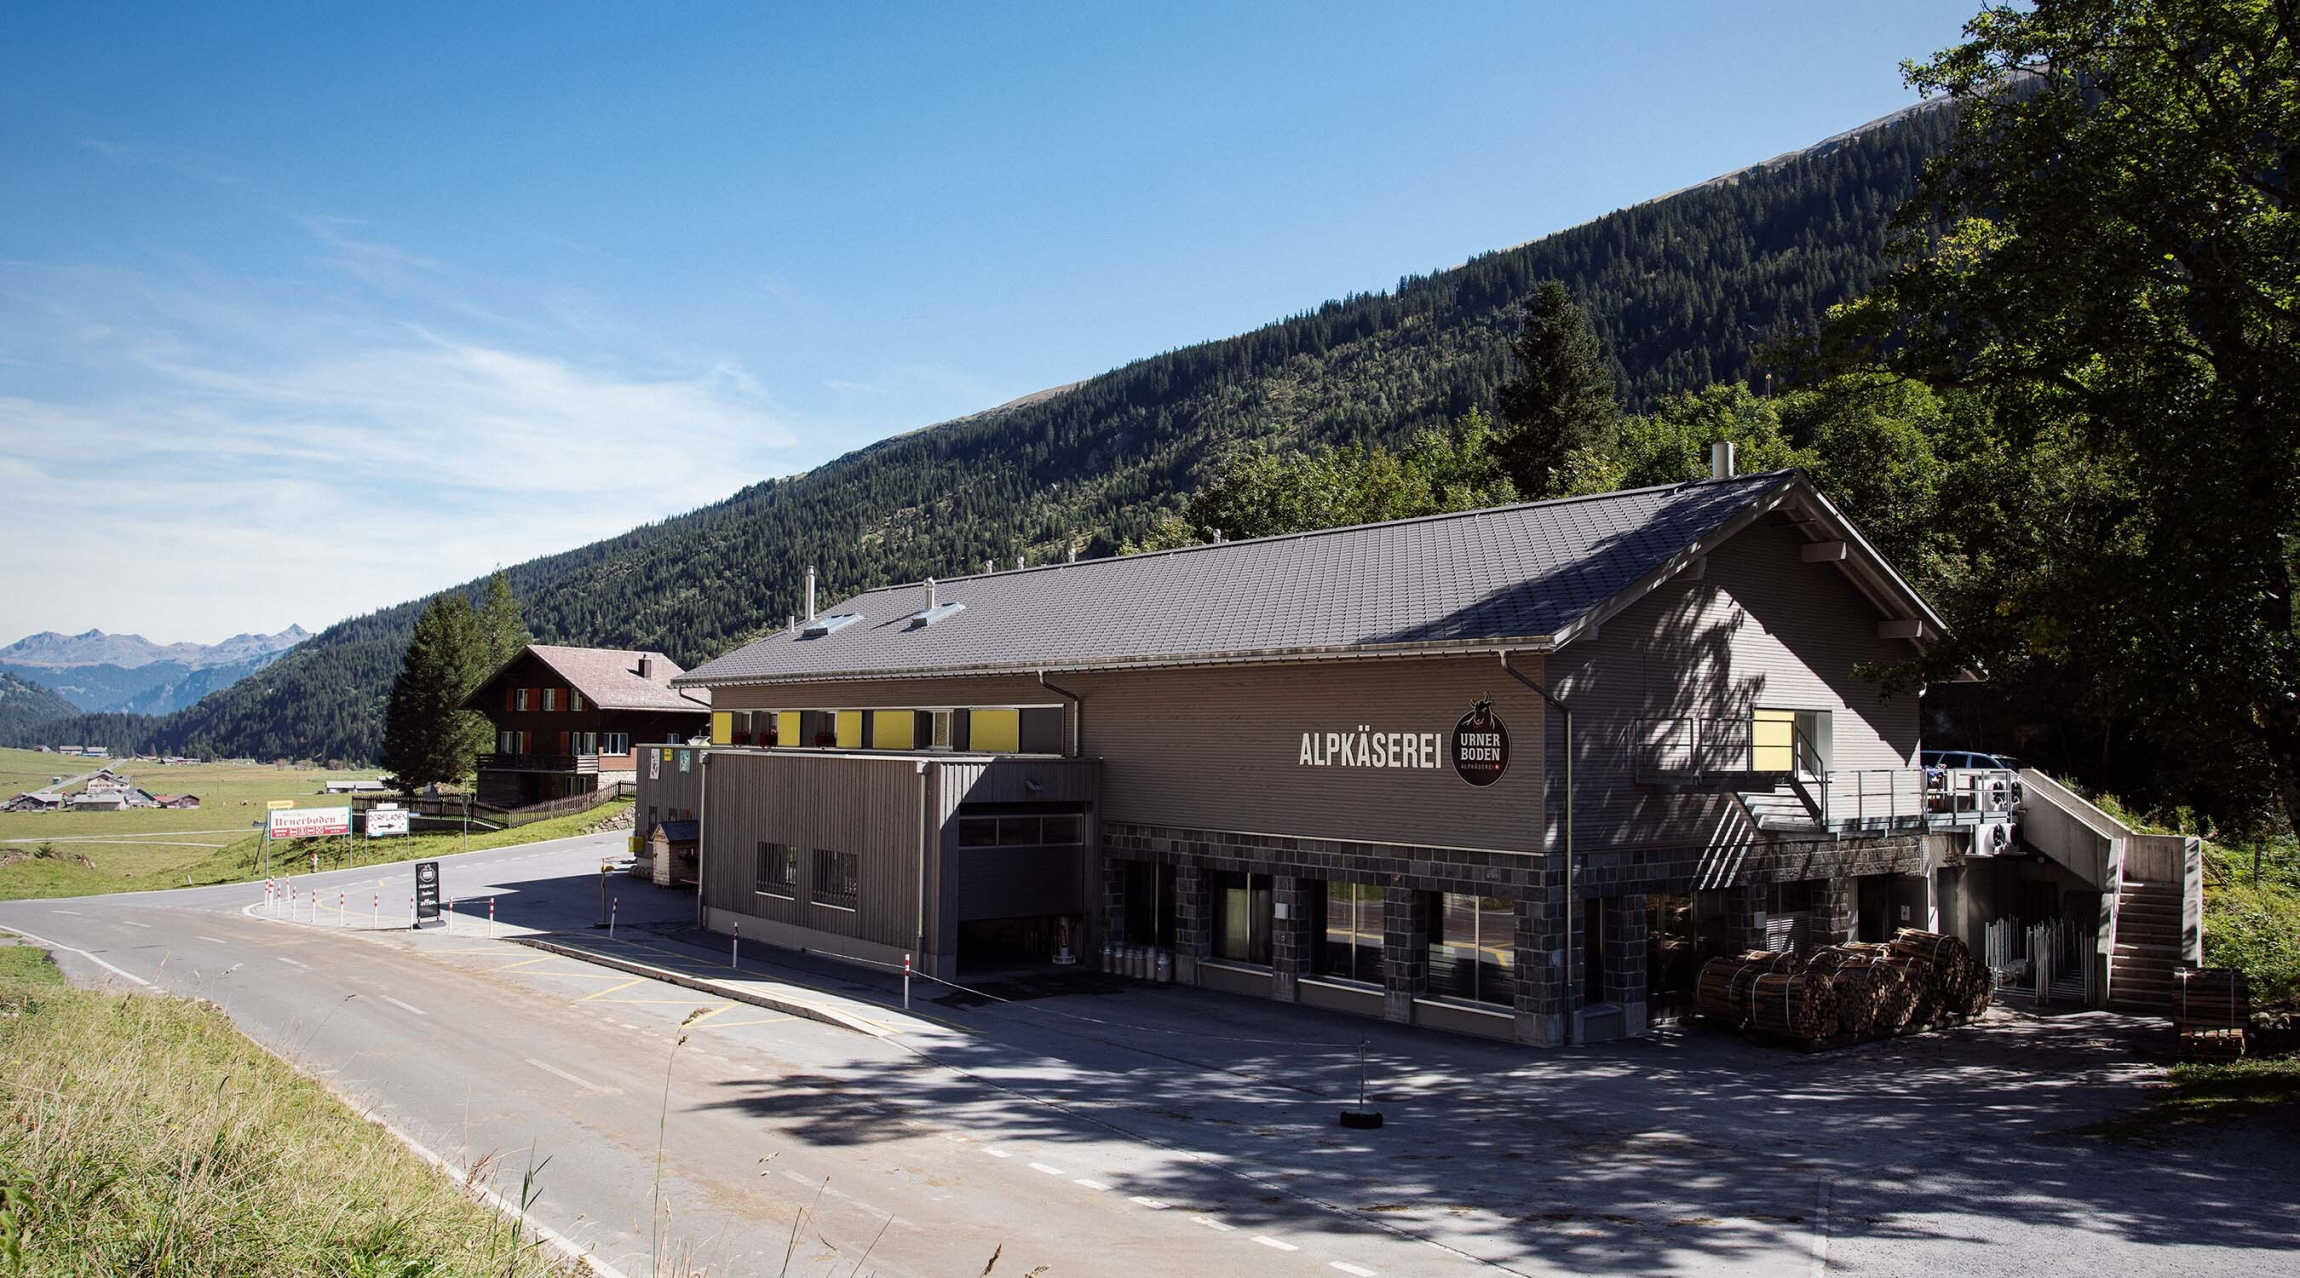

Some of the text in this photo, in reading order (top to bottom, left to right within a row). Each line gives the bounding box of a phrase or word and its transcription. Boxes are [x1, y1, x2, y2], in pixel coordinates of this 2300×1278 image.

[1299, 725, 1442, 769] ALPKÄSEREI
[1460, 733, 1501, 747] URNER
[1460, 747, 1501, 761] BODEN
[275, 816, 336, 826] Urnerboden
[369, 813, 407, 821] DORFLADEN
